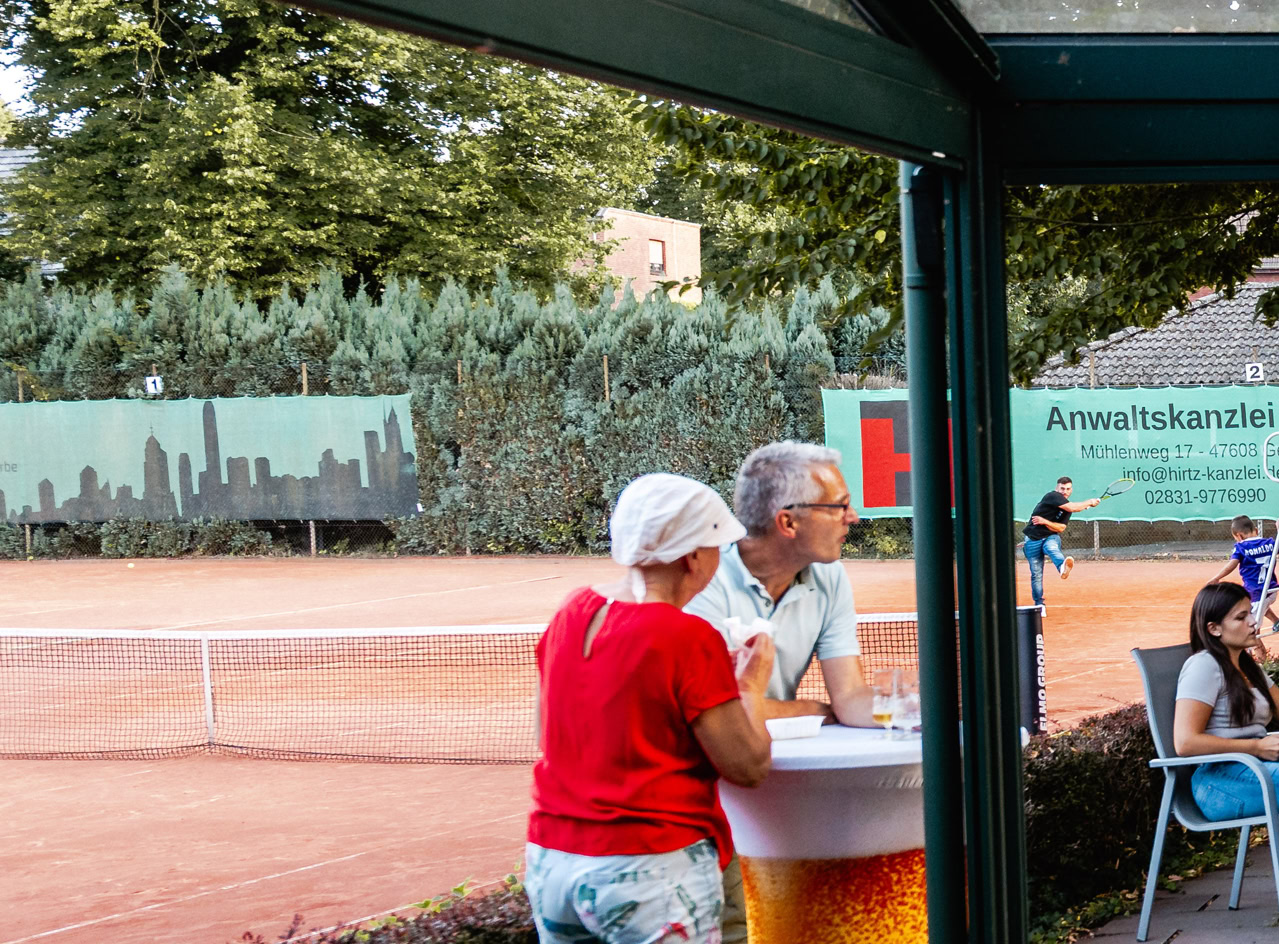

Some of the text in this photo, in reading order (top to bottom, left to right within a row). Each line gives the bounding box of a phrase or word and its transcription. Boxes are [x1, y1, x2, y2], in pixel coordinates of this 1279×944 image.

[1250, 365, 1260, 379] 2
[1046, 402, 1275, 431] Anwaltskanzlei
[1081, 444, 1169, 462] Mühlenweg
[1175, 444, 1193, 459] 17
[1209, 443, 1258, 458] 47608
[1144, 487, 1267, 505] 02831-9776990
[1255, 555, 1271, 585] 7
[1035, 633, 1046, 687] GROUP
